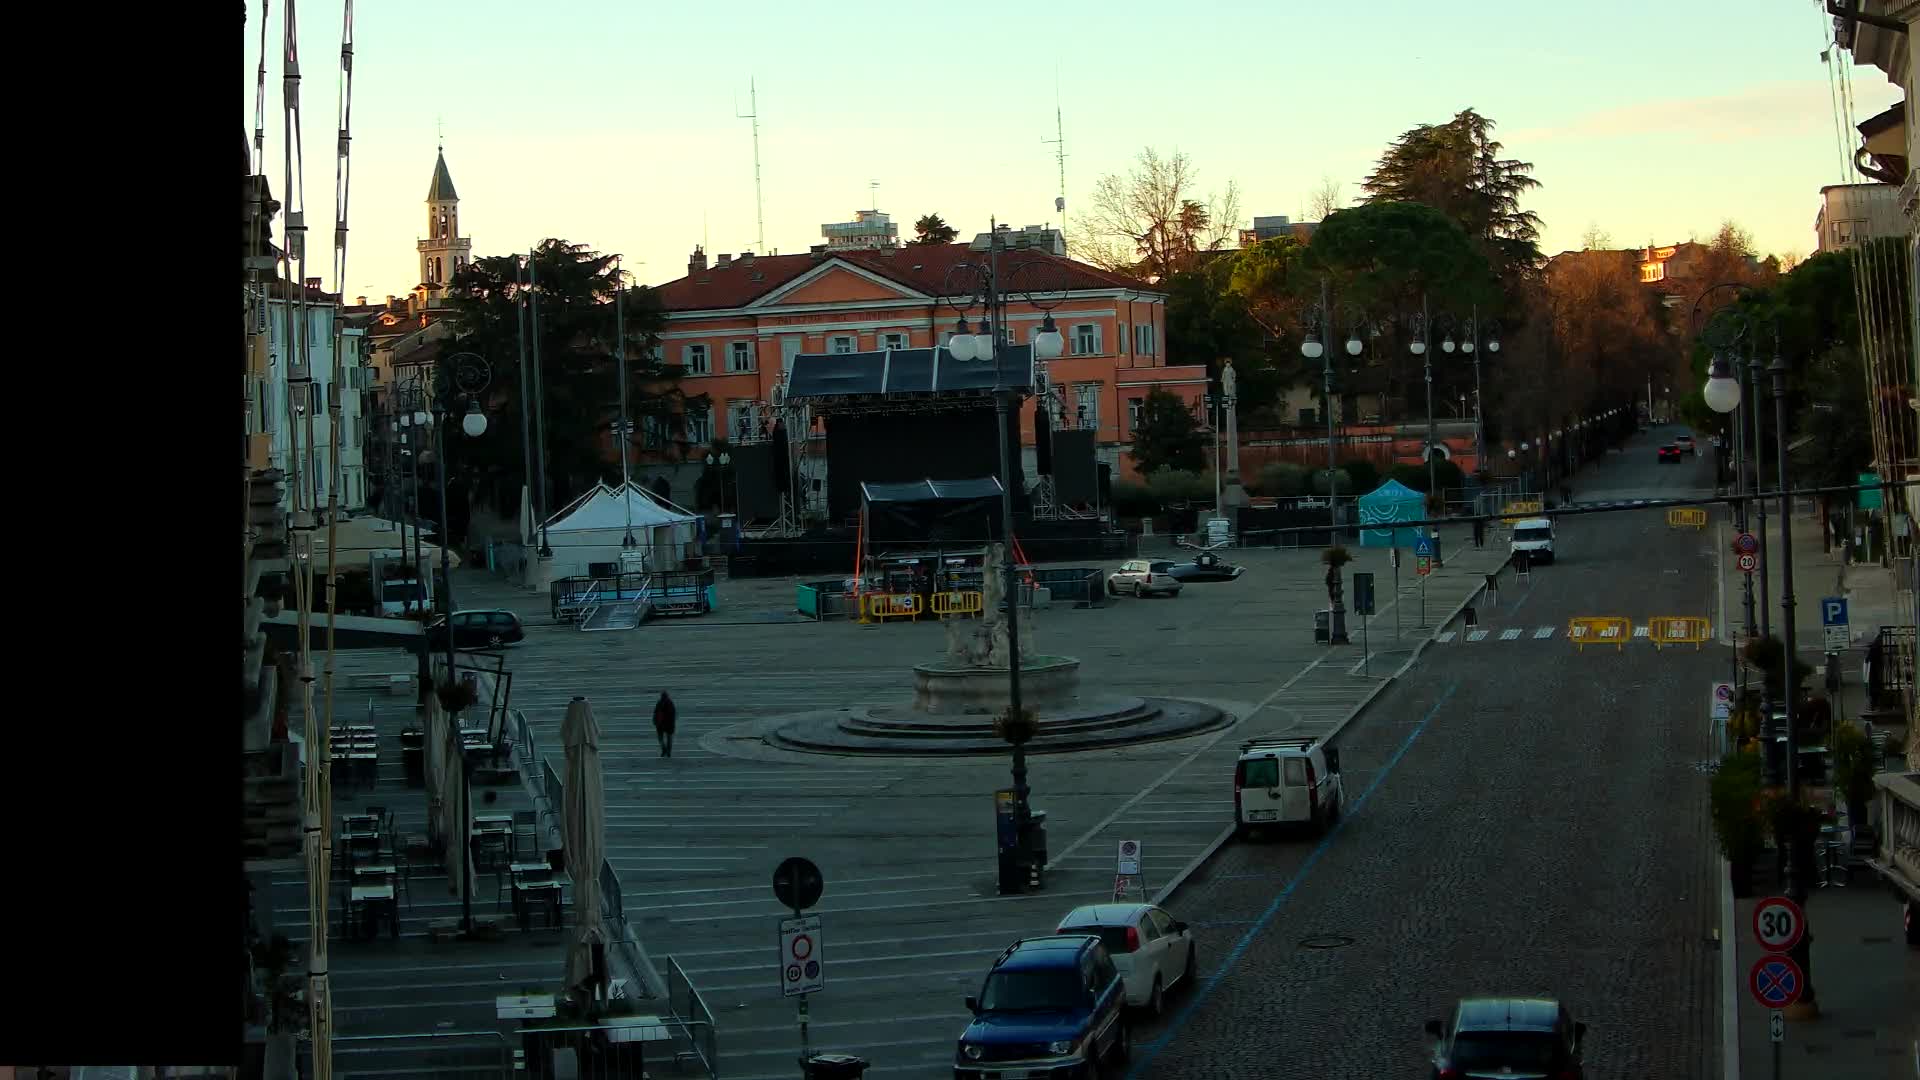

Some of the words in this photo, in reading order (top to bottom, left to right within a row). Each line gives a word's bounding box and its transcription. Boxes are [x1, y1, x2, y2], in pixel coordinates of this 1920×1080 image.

[1742, 557, 1753, 567] 20
[1827, 602, 1842, 622] P
[1762, 911, 1791, 937] 30
